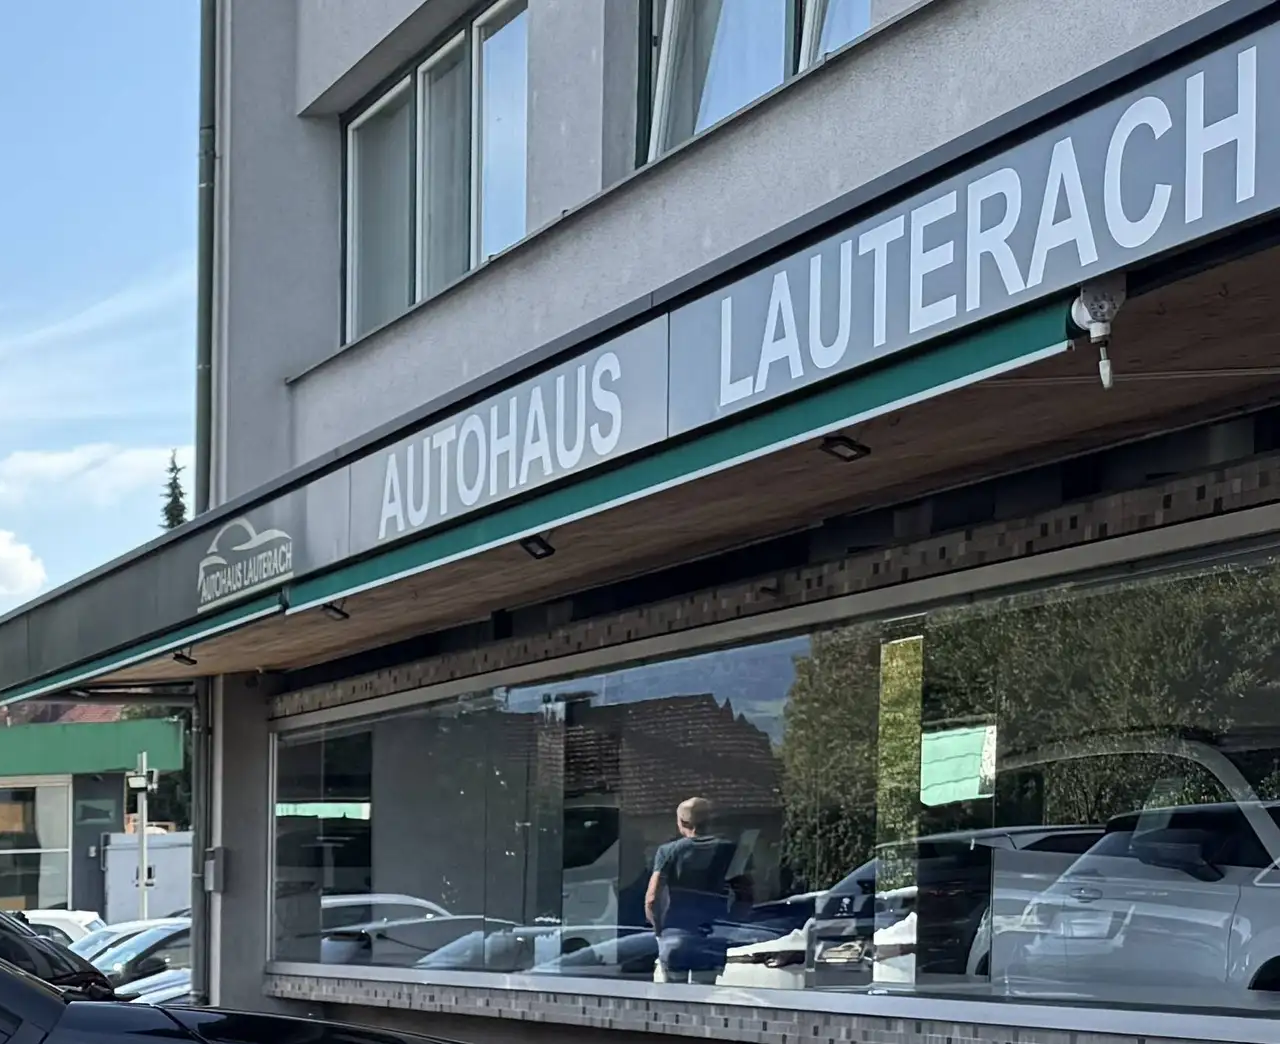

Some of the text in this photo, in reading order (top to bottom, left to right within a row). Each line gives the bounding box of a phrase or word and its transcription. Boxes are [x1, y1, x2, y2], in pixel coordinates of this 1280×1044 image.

[378, 46, 1257, 540] AUTOHAUS LAUTERACH
[200, 541, 292, 604] AUTOHAUS LAUTERACH
